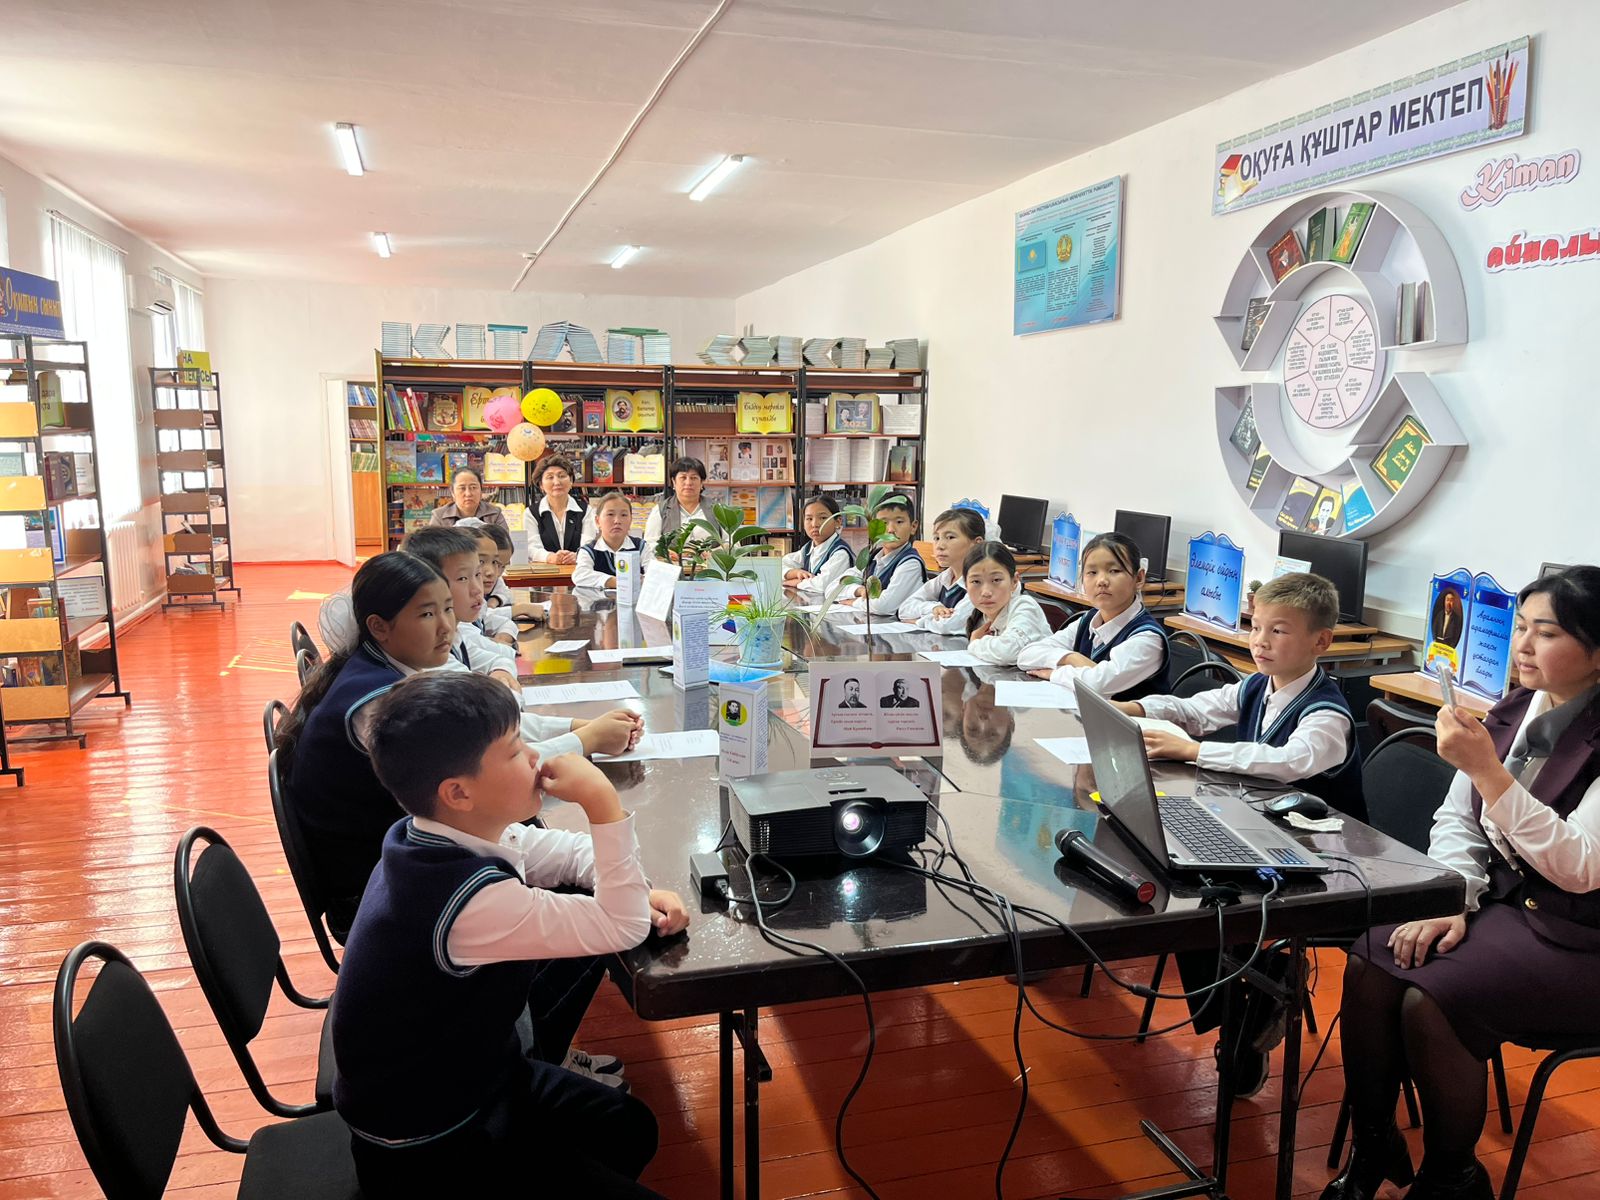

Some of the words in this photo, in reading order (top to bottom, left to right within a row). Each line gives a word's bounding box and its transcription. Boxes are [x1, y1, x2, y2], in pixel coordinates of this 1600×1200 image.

[1240, 140, 1294, 181] ОҚУҒА
[1300, 111, 1382, 167] ҚҰШТАР
[1389, 77, 1483, 136] МЕКТЕП
